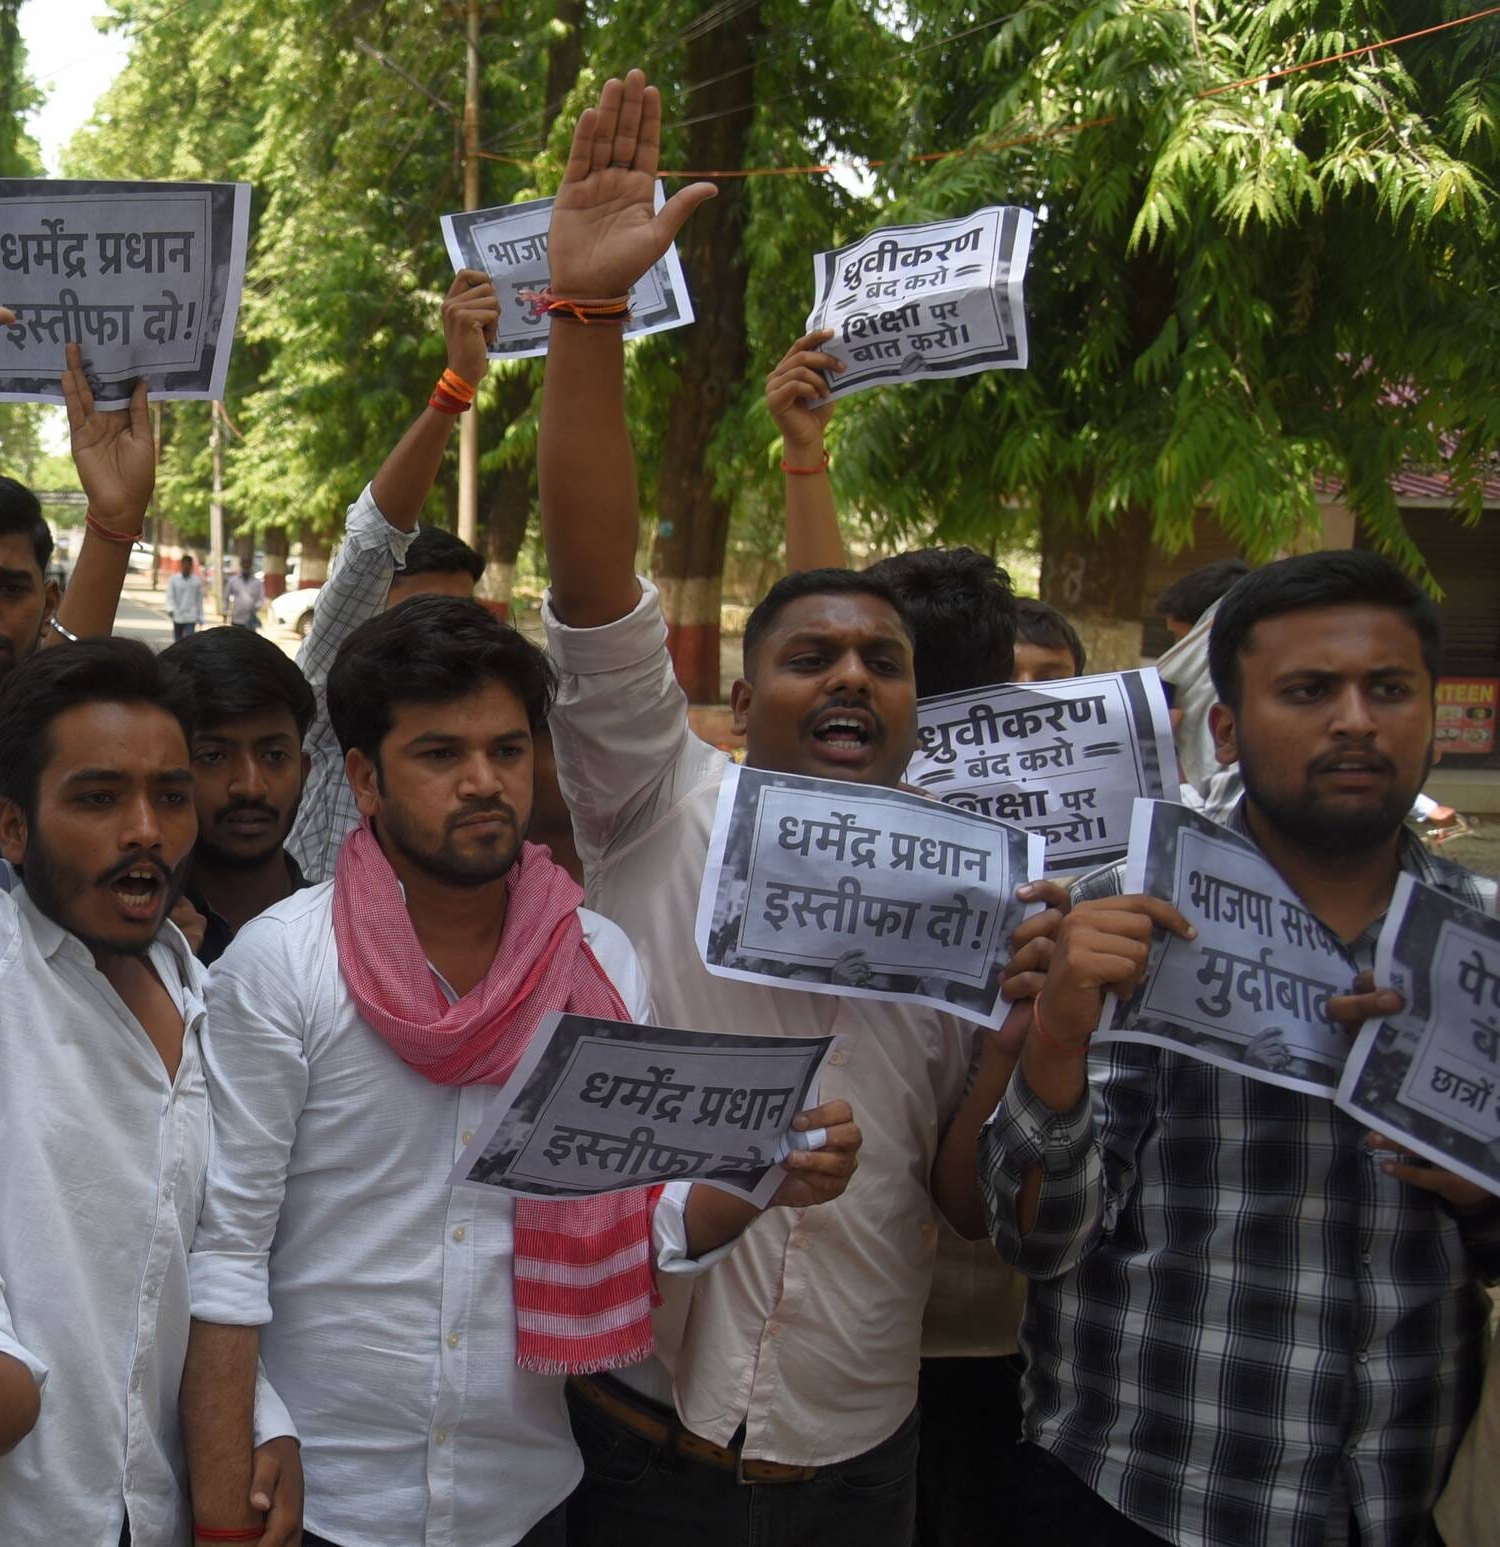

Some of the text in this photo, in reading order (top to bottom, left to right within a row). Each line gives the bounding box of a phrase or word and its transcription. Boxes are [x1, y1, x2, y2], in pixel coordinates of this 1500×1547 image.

[0, 218, 195, 279] धर्मेंद्र प्रधान
[843, 227, 984, 291] ध्रुवीकरण
[866, 265, 950, 299] बंद करो
[2, 288, 196, 350] इस्तीफा दो!
[842, 301, 961, 343] शिक्षा पर
[850, 338, 901, 362] बात
[918, 695, 1108, 764] ध्रुवीकरण
[964, 737, 1074, 779] बंद करो
[1060, 788, 1097, 811] पर
[778, 812, 991, 882] धर्मेंद्र प्रधान
[763, 876, 988, 950] इस्तीफा दो!
[1188, 870, 1273, 938] भाजपा
[1197, 948, 1350, 1034] मुर्दाबाद
[579, 1066, 794, 1131] धर्मेंद्र प्रधान
[1431, 1066, 1495, 1113] छात्रों
